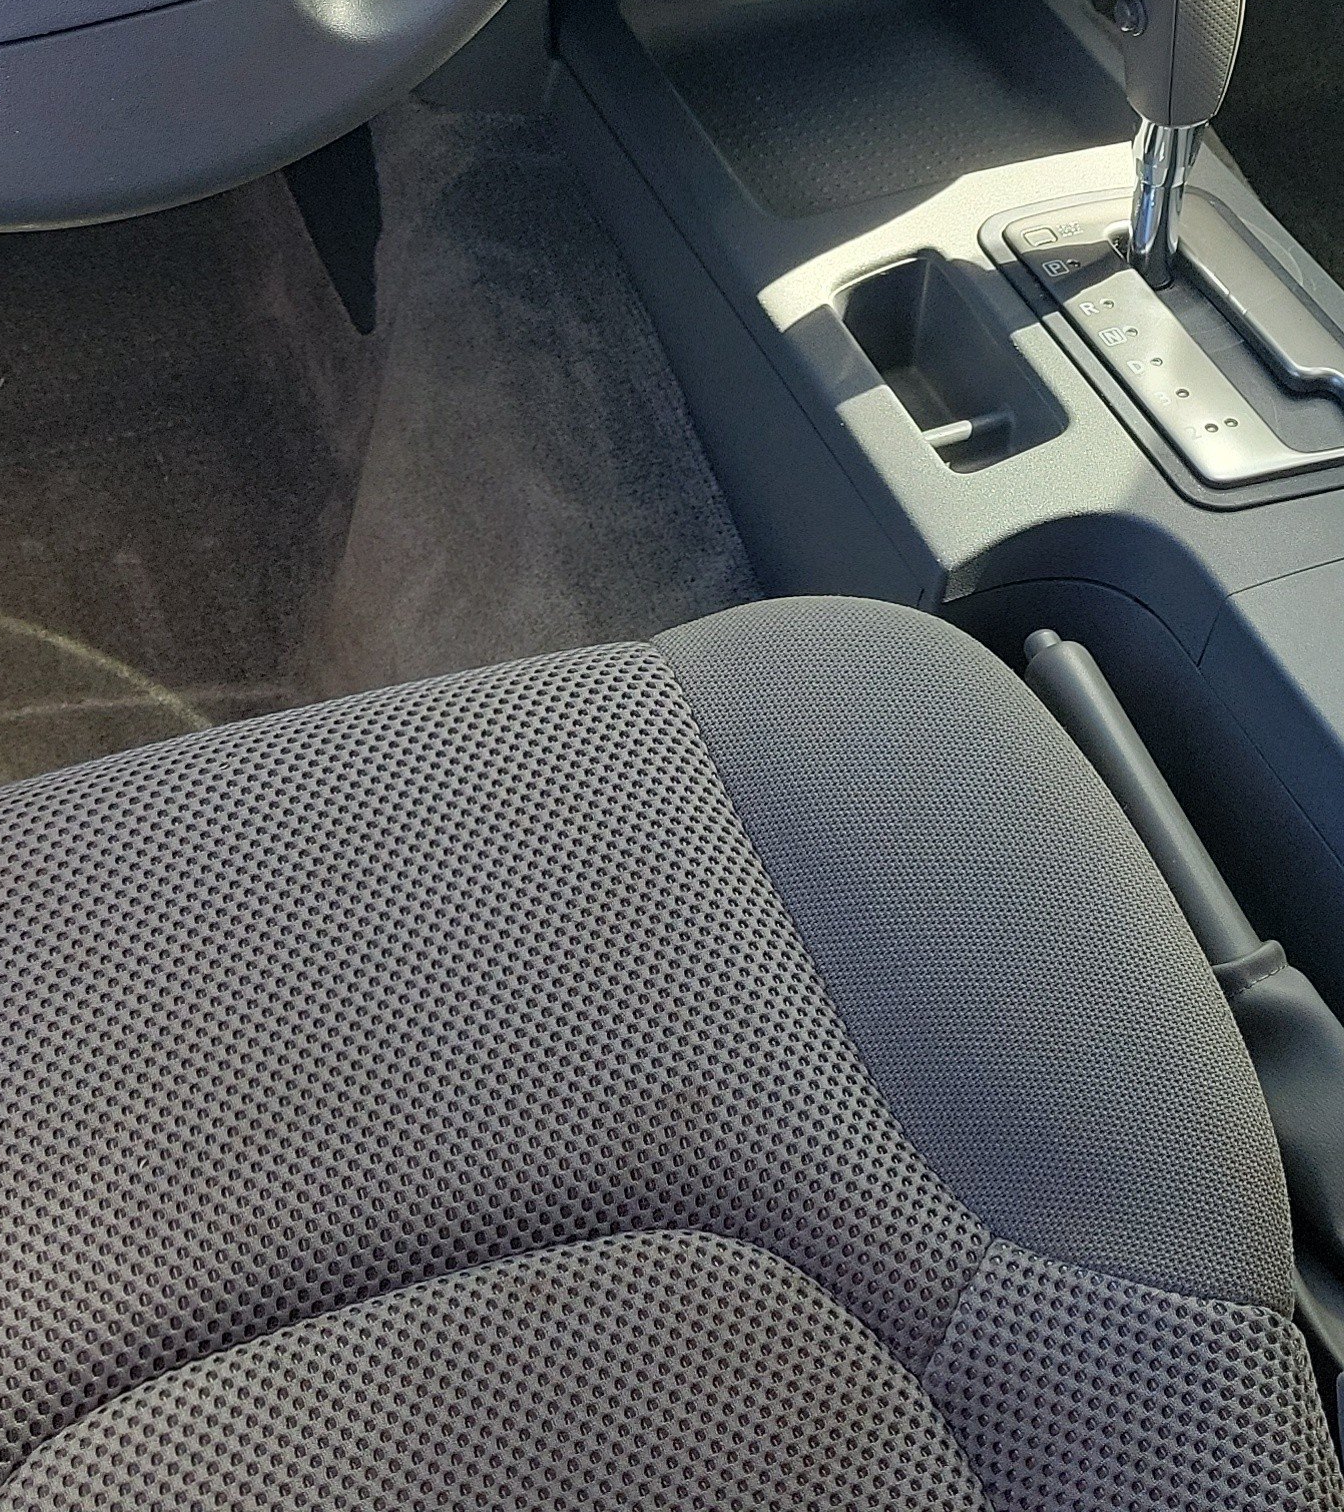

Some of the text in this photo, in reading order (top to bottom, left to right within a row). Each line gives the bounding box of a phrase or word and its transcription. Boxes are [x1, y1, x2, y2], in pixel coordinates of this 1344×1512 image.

[1047, 262, 1064, 275] P
[1079, 302, 1100, 317] R
[1102, 327, 1124, 345] N
[1126, 360, 1145, 376] D
